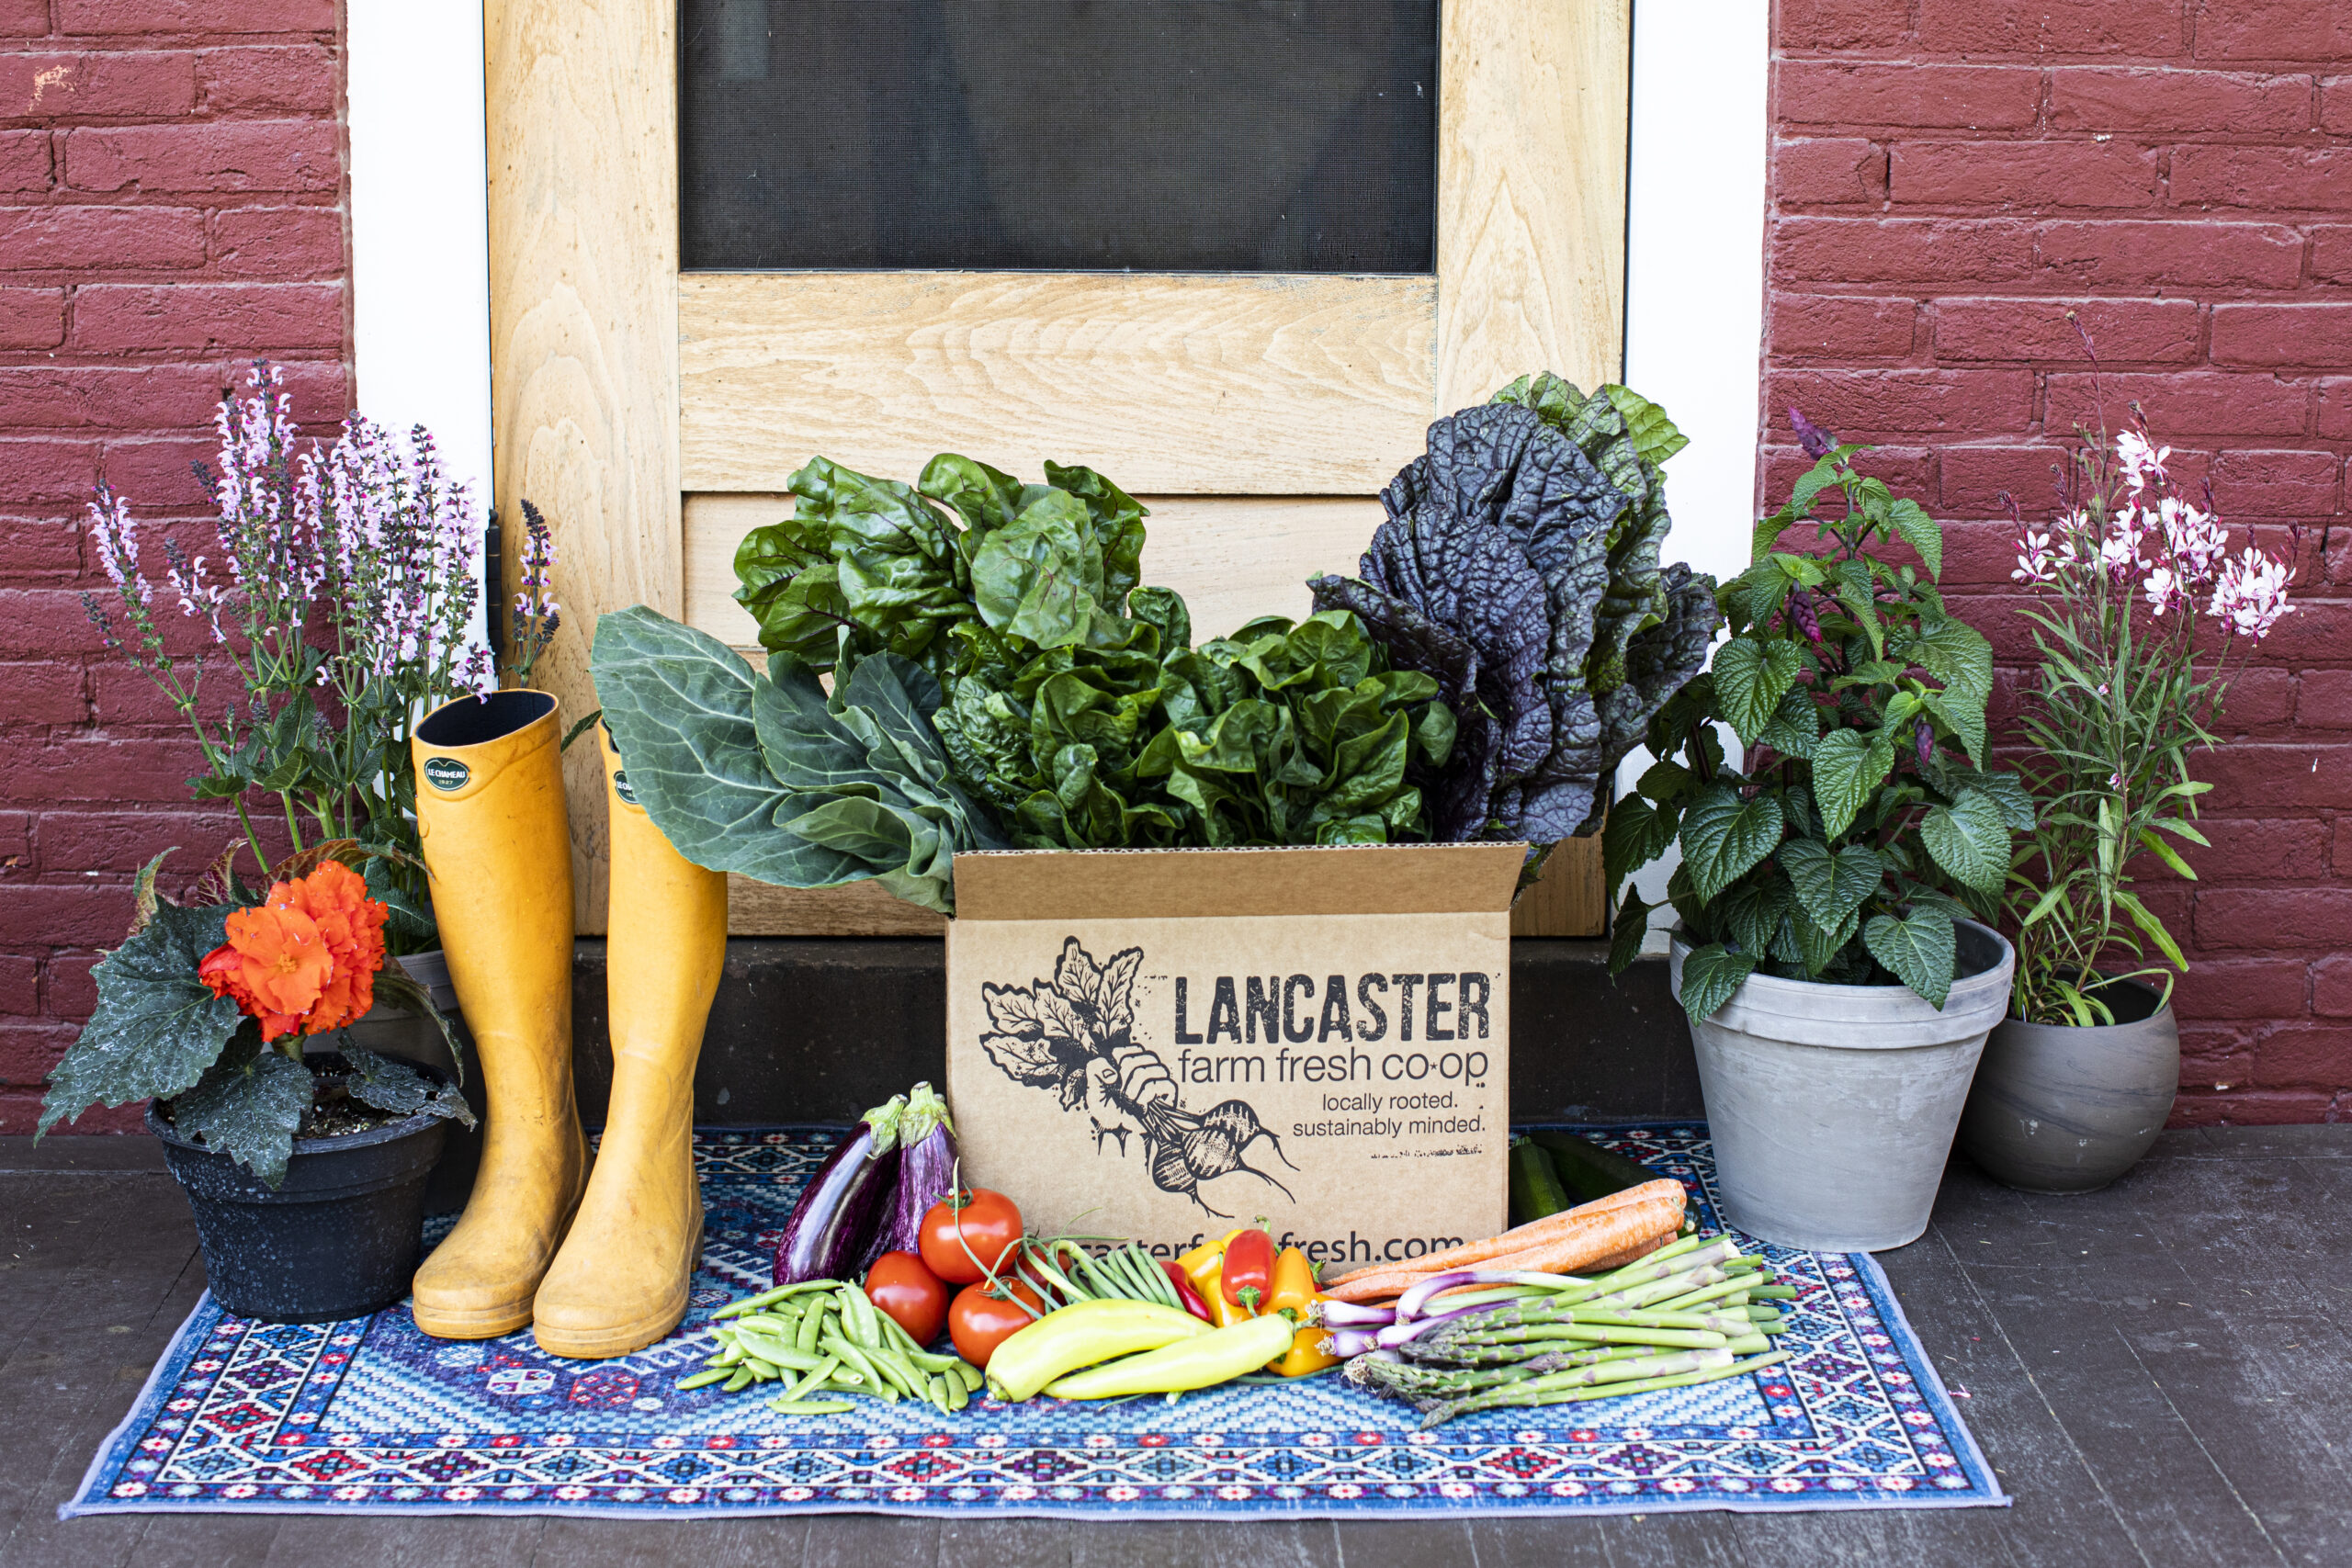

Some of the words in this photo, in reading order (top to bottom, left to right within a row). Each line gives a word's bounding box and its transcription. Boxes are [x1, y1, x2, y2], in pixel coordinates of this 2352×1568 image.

[428, 768, 435, 776] LE
[435, 770, 466, 778] CHAMEAU
[1175, 972, 1490, 1044] LANCASTER
[1178, 1048, 1265, 1082] farm
[1276, 1046, 1371, 1082] fresh
[1323, 1093, 1383, 1113] locally
[1389, 1090, 1458, 1110] rooted.
[1293, 1118, 1402, 1138] sustainably
[1408, 1114, 1486, 1134] minded.
